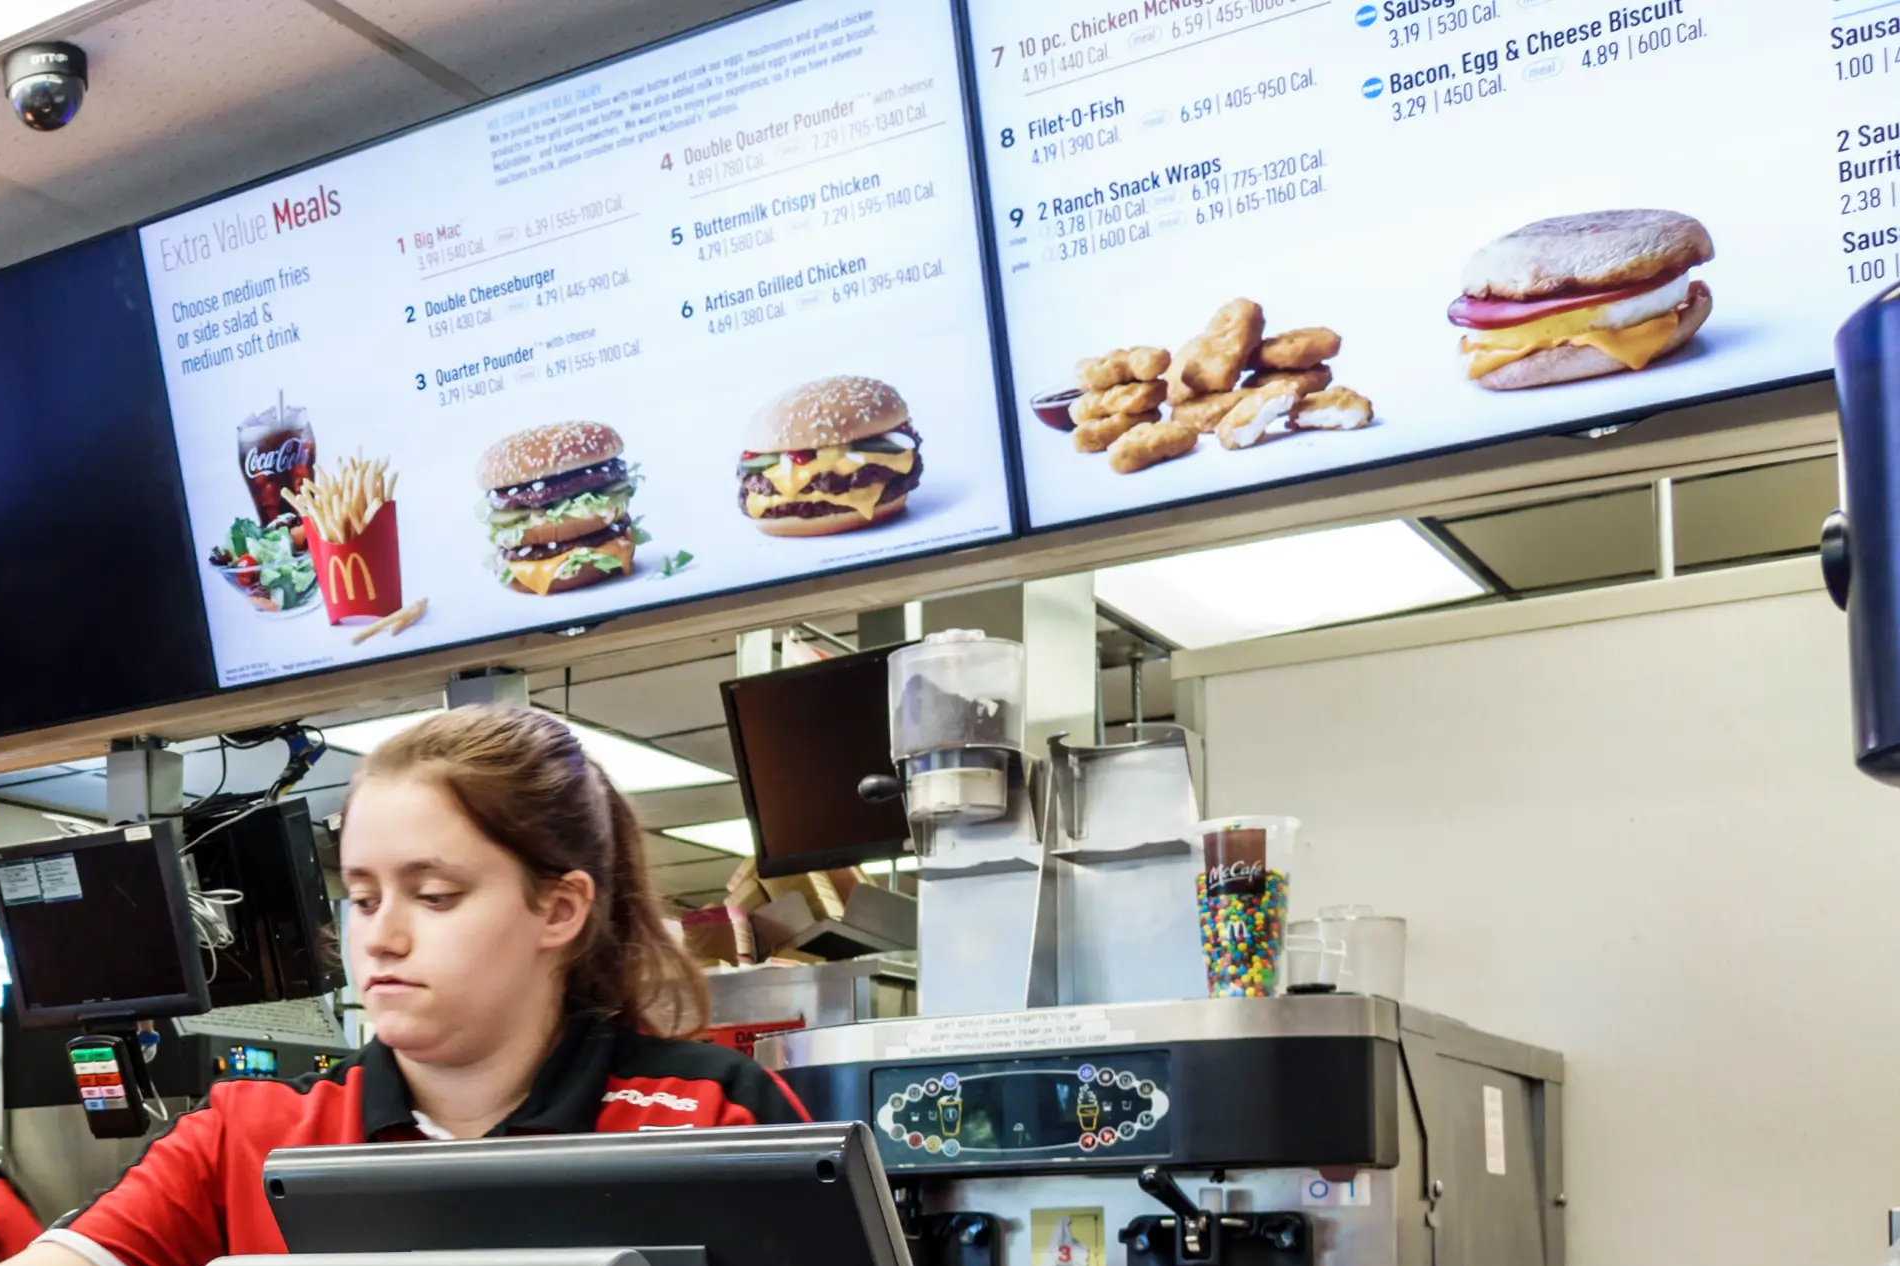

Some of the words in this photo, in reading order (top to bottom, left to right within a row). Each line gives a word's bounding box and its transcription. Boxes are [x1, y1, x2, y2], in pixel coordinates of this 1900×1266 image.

[992, 46, 1004, 69] 7
[1018, 38, 1037, 60] 10
[1041, 31, 1067, 57] pc.
[1070, 6, 1139, 43] Chicken
[1390, 63, 1456, 95] Bacon,
[1461, 51, 1499, 76] Egg
[1505, 39, 1520, 61] &
[1526, 19, 1603, 56] Cheese
[1608, 0, 1684, 32] Biscuit
[660, 152, 674, 172] 4
[684, 135, 733, 166] Double
[736, 118, 789, 151] Quarter
[793, 99, 855, 133] Pounder
[873, 87, 895, 106] with
[898, 76, 935, 99] cheese
[1000, 128, 1015, 149] 8
[671, 227, 684, 246] 5
[694, 203, 768, 240] Buttermilk
[771, 190, 817, 220] Crispy
[820, 172, 881, 203] Chicken
[1009, 207, 1024, 229] 9
[1038, 201, 1048, 221] 2
[1053, 184, 1104, 217] Ranch
[1108, 171, 1160, 203] Snack
[1165, 157, 1222, 188] Wraps
[161, 230, 211, 272] Extra
[214, 212, 268, 254] Value
[272, 185, 342, 234] Meals
[397, 236, 406, 254] 1
[414, 230, 433, 251] Big
[436, 224, 462, 244] Mac
[171, 293, 220, 324] Choose
[223, 277, 276, 311] medium
[279, 264, 311, 293] fries
[404, 306, 416, 324] 2
[425, 291, 466, 318] Double
[469, 267, 556, 308] Cheeseburger
[681, 299, 694, 318] 6
[705, 282, 754, 314] Artisan
[757, 270, 804, 300] Grilled
[807, 255, 867, 287] Chicken
[177, 330, 190, 350] or
[193, 316, 220, 344] side
[223, 306, 260, 337] salad
[262, 300, 273, 322] &
[182, 342, 234, 376] medium
[237, 332, 265, 360] soft
[268, 322, 301, 351] drink
[415, 374, 427, 391] 3
[435, 358, 480, 388] Quarter
[483, 345, 534, 375] Pounder
[546, 333, 563, 350] with
[565, 325, 597, 347] cheese
[1057, 1244, 1071, 1263] 3
